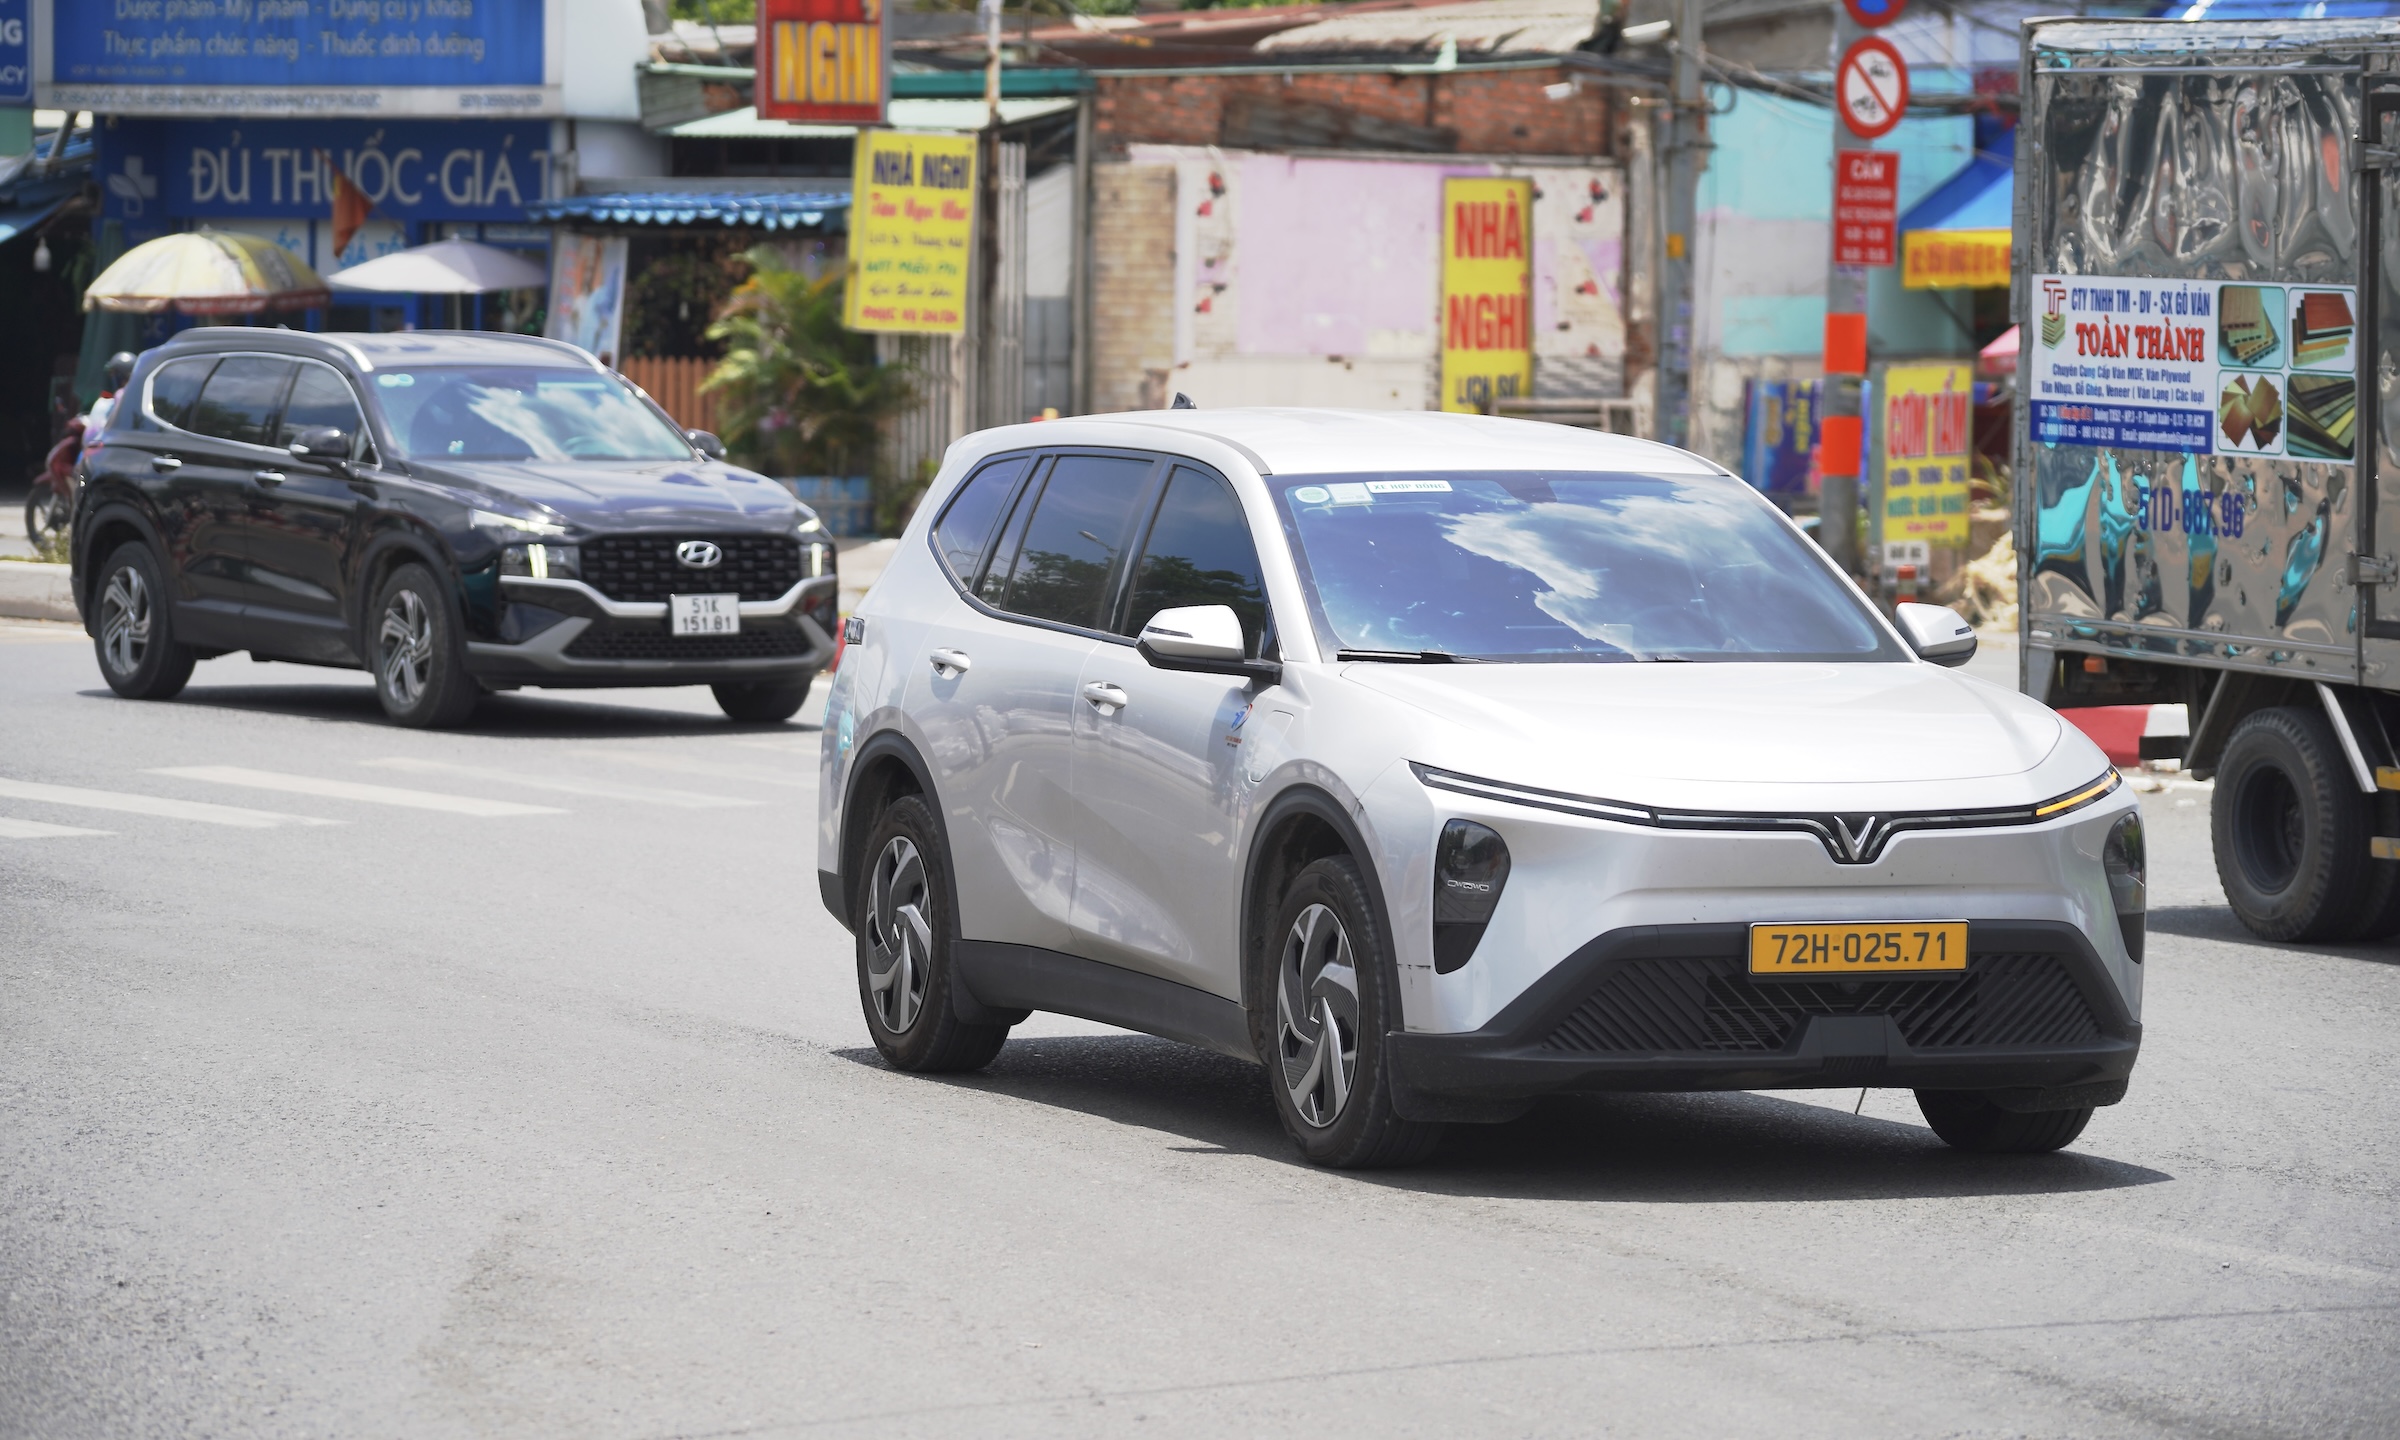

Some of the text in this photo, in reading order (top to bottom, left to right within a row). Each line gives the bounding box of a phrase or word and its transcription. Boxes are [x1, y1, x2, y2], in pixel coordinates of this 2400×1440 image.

[205, 32, 249, 56] chức
[320, 29, 378, 57] Thuốc
[189, 130, 250, 203] ĐỦ
[872, 143, 914, 186] NHÀ
[1455, 188, 1524, 260] NHÀ
[1448, 272, 1528, 351] NGHỈ
[2071, 287, 2088, 311] CTY
[2090, 288, 2114, 312] TNHH
[2116, 289, 2130, 312] TM
[2140, 290, 2151, 313] DV
[2160, 290, 2173, 315] SX
[2176, 283, 2188, 316] GỖ
[2191, 287, 2210, 316] VÁN
[2075, 314, 2206, 362] TOÀN THÀNH
[2052, 363, 2078, 379] Chuyên
[2079, 364, 2096, 380] Cung
[2098, 364, 2110, 380] Cấp
[2127, 367, 2145, 382] MDF,
[2161, 369, 2191, 384] Plywood
[2076, 380, 2085, 395] Gỗ
[2106, 384, 2130, 398] Veneer
[2152, 387, 2169, 402] Lạng
[2176, 388, 2189, 402] Các
[2191, 389, 2205, 404] loại
[692, 597, 720, 614] 51K
[683, 615, 732, 632] 151.81
[1772, 931, 1946, 964] 72H-025.71
